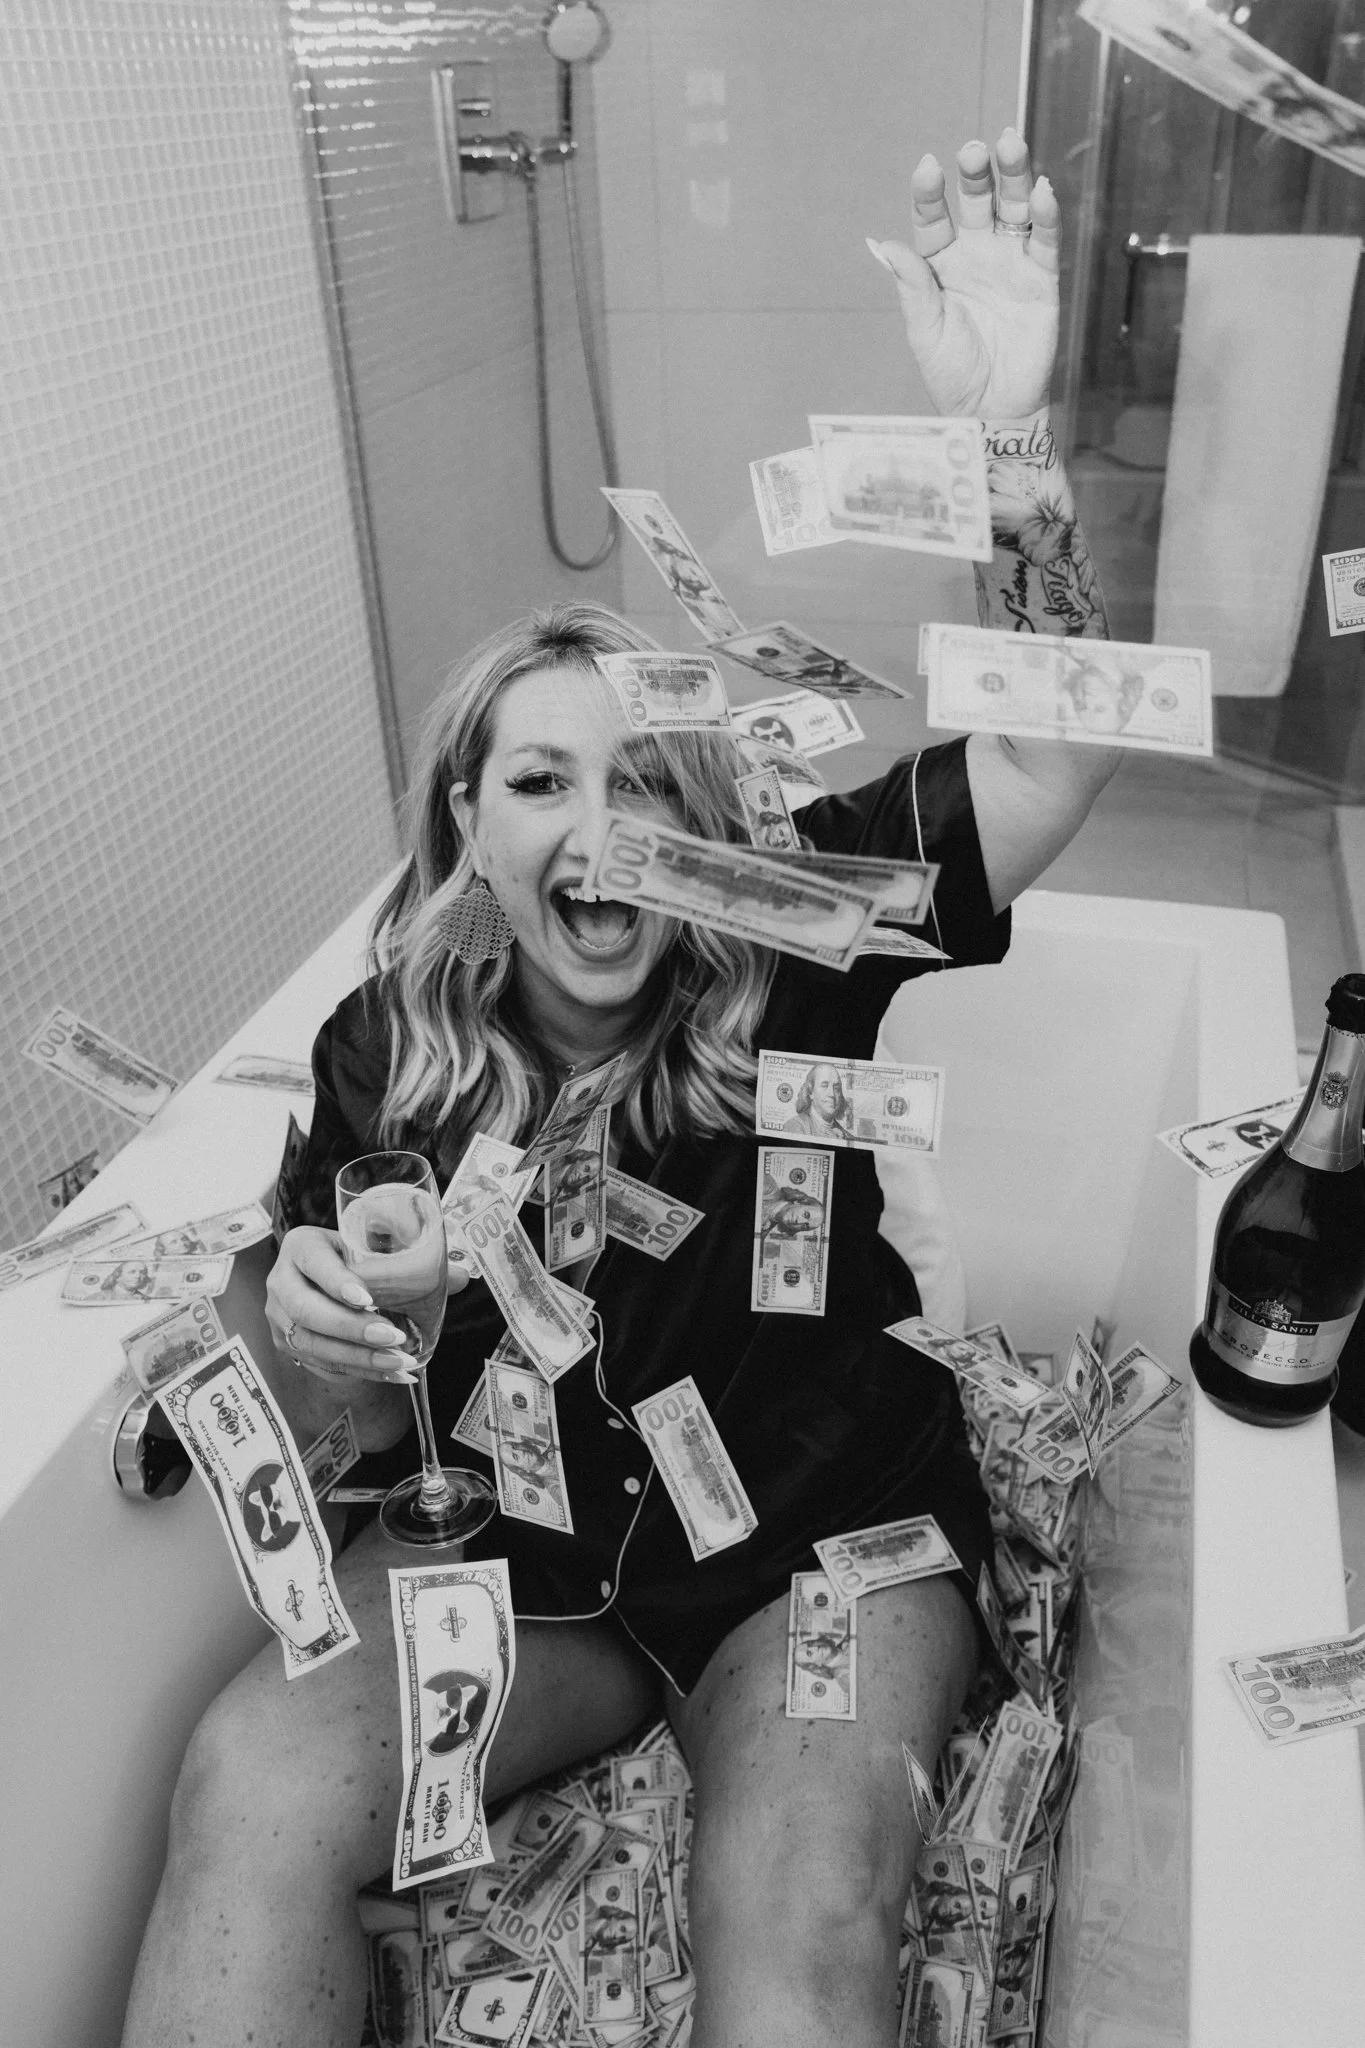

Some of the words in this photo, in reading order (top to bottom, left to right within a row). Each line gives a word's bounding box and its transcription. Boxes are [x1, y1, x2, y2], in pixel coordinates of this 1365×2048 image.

[604, 831, 650, 890] 100
[34, 1020, 73, 1059] 100
[470, 1207, 511, 1249] 100
[648, 1210, 690, 1247] 100
[1232, 1301, 1267, 1326] VILLA
[1271, 1321, 1314, 1334] SANDI
[1223, 1330, 1309, 1364] PROSECCO
[226, 1383, 240, 1403] RAIN
[236, 1403, 245, 1412] IT
[207, 1390, 248, 1449] 1000
[241, 1412, 256, 1434] MAKE
[260, 1402, 273, 1420] ONLY
[646, 1393, 692, 1430] 100
[196, 1419, 219, 1456] SUPPLIES
[269, 1419, 281, 1436] PROP
[277, 1435, 284, 1445] AS
[204, 1445, 216, 1462] FOR
[280, 1444, 291, 1462] USED
[329, 1423, 350, 1468] 100
[1029, 1438, 1075, 1473] 100
[217, 1457, 234, 1482] PARTY
[295, 1488, 306, 1509] LEGAL
[302, 1509, 311, 1524] NOT
[307, 1523, 314, 1531] IS
[310, 1530, 320, 1549] NOTE
[316, 1548, 324, 1564] THIS
[829, 1546, 863, 1590] 100
[399, 1579, 414, 1626] 1000
[1242, 1664, 1295, 1729] 100
[1006, 1714, 1047, 1746] 100
[461, 1750, 472, 1776] PARTY
[424, 1785, 432, 1809] MAKE
[432, 1778, 450, 1840] 1000
[423, 1811, 430, 1819] IT
[421, 1822, 429, 1843] RAIN
[400, 1828, 413, 1878] 1000
[495, 1908, 538, 1947] 100
